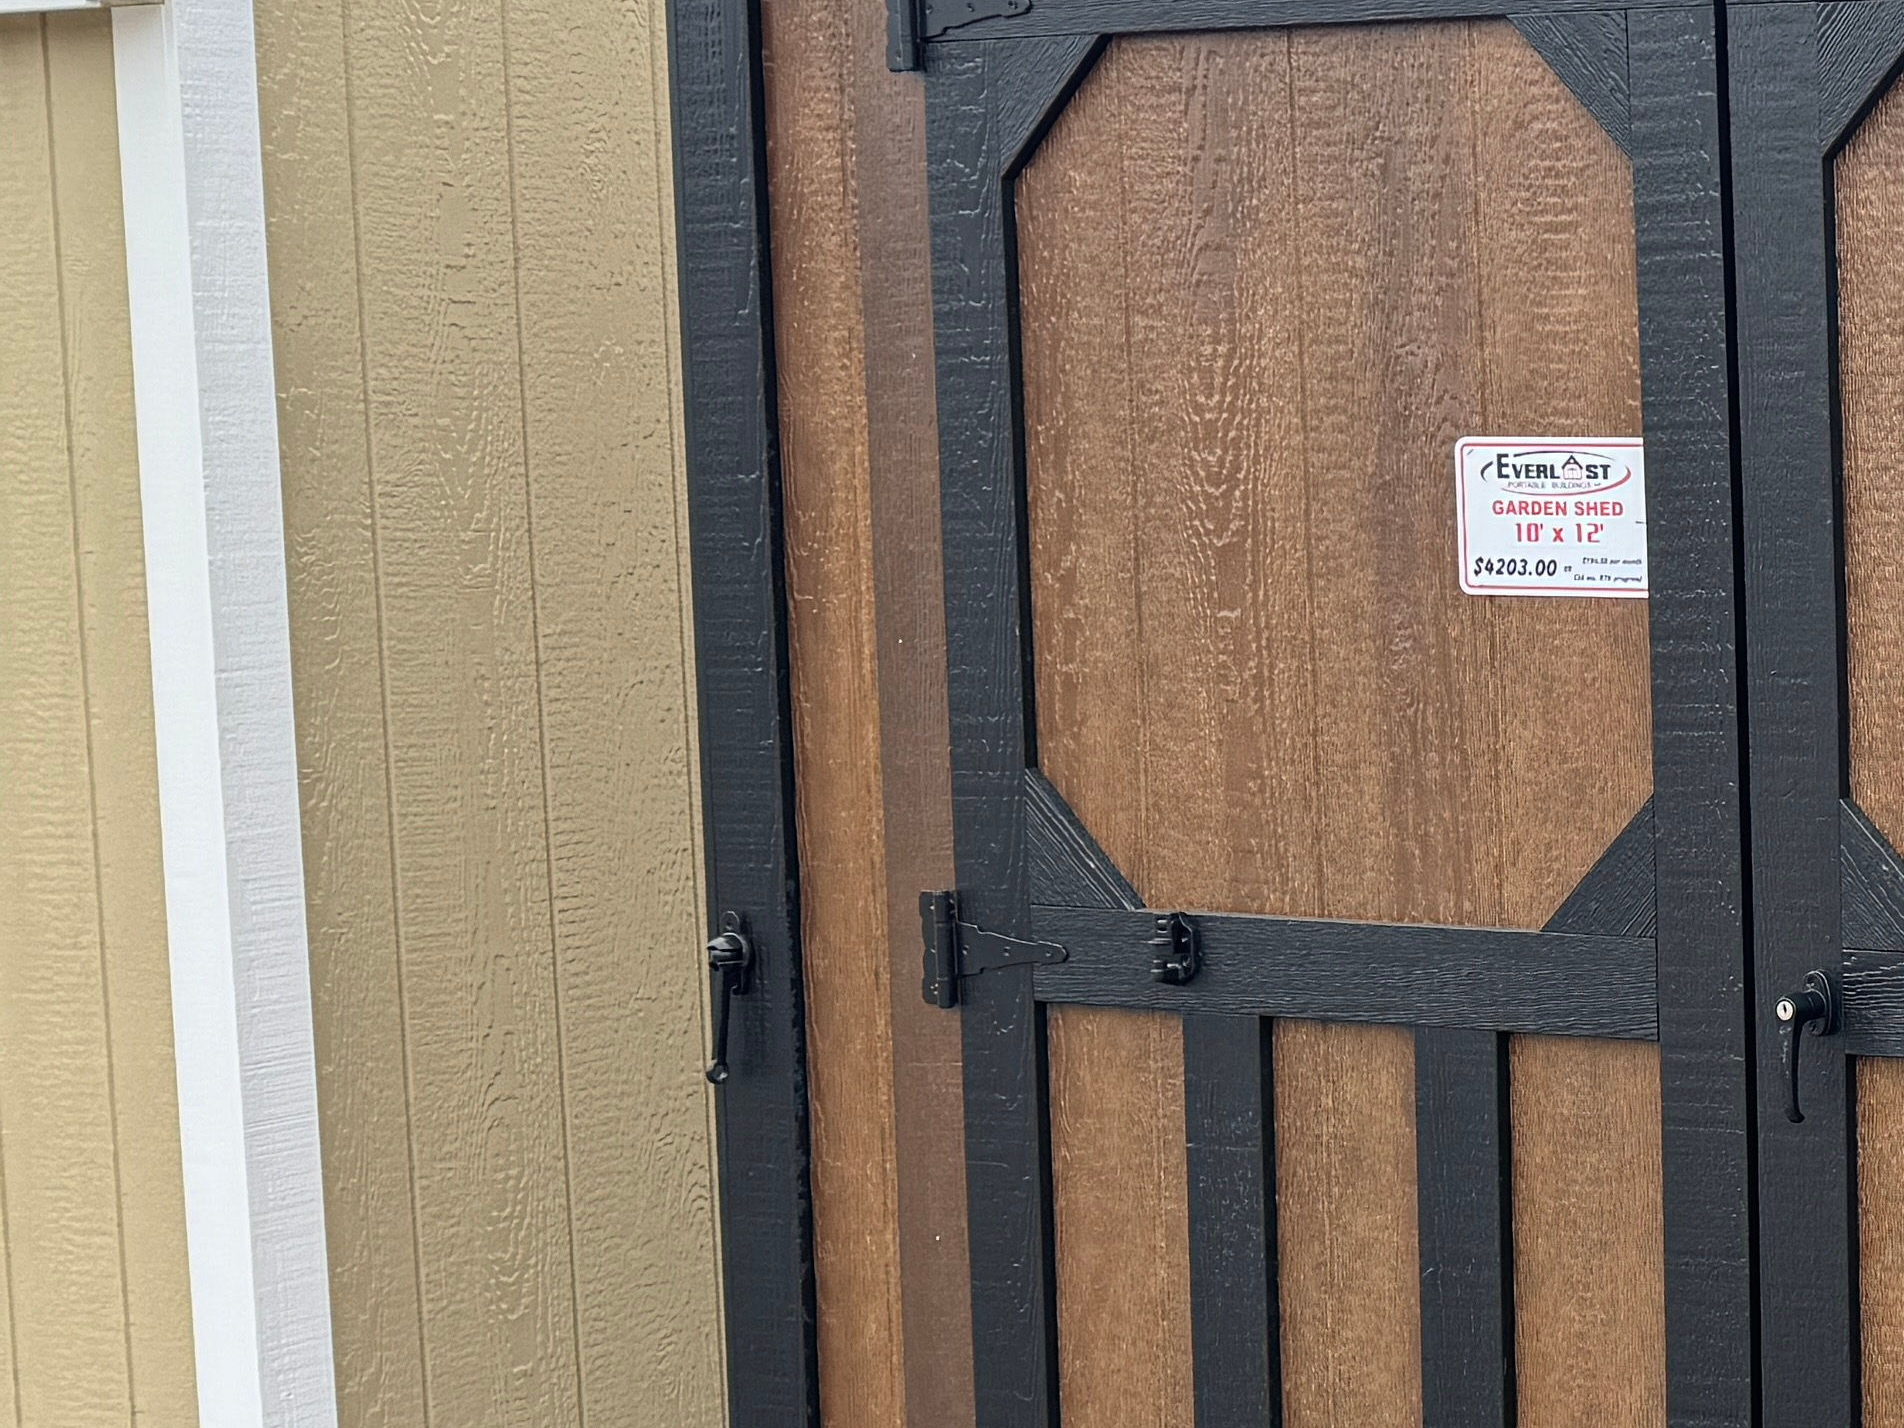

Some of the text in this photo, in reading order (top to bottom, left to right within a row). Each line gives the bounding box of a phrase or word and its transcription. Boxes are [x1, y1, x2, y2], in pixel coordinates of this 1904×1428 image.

[1496, 453, 1611, 480] EVERLAST
[1492, 500, 1624, 516] GARDEN SHED
[1515, 523, 1543, 542] 10'
[1575, 523, 1604, 543] 12'
[1474, 556, 1557, 578] $4203.00
